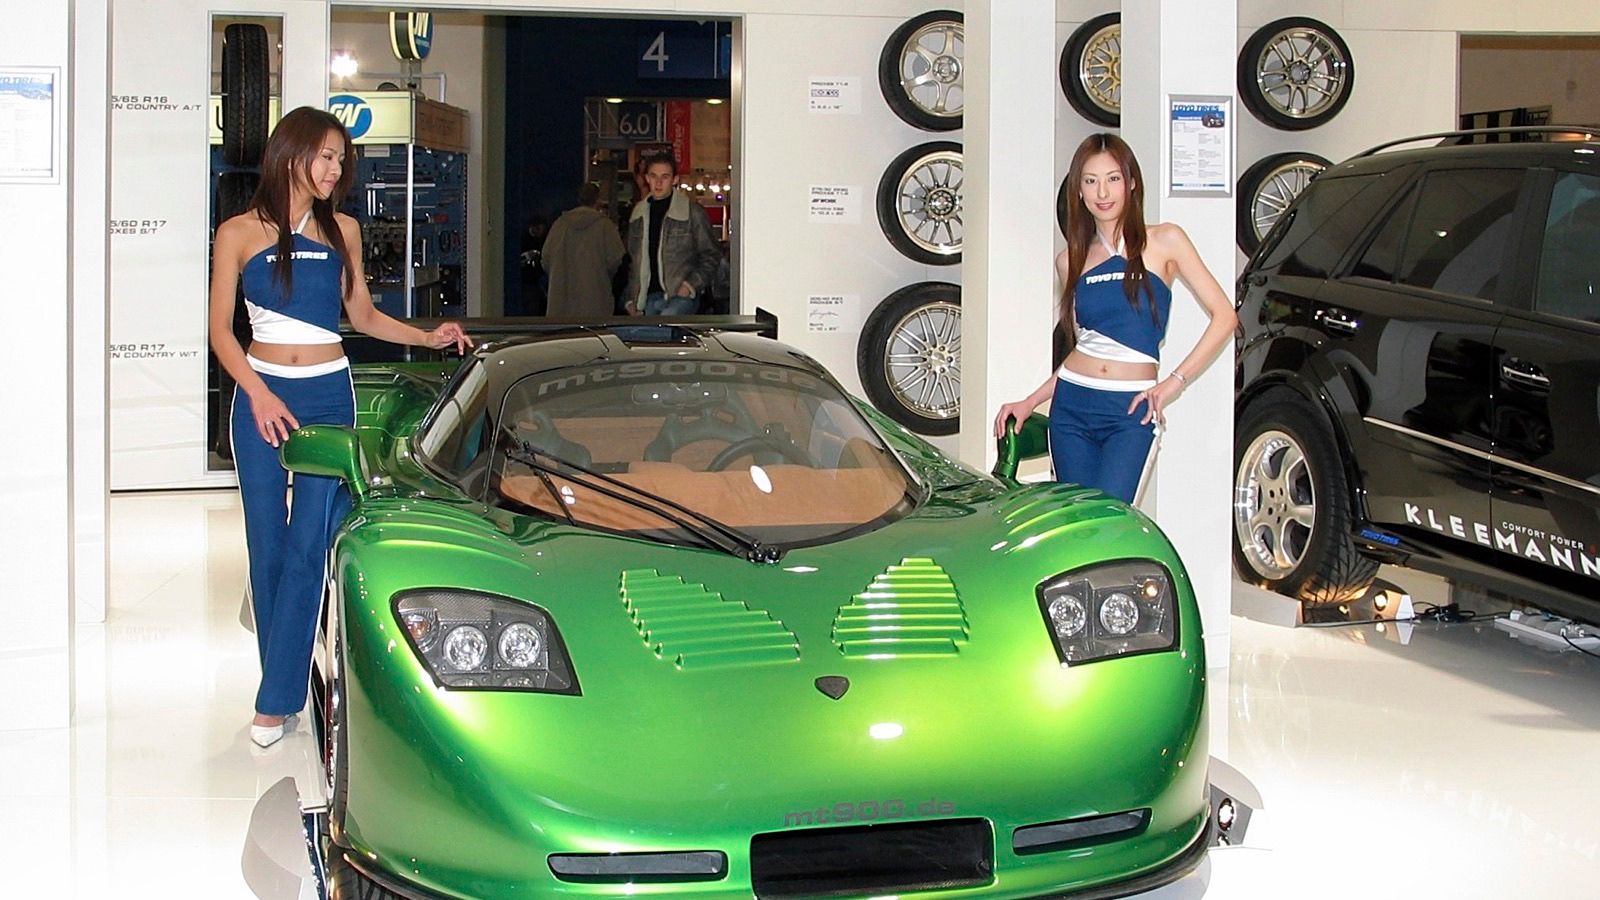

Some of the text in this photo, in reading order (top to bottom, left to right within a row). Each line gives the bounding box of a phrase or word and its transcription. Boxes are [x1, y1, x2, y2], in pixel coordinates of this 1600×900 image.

[642, 31, 669, 72] 4
[143, 95, 168, 103] R16
[126, 103, 178, 111] COUNTRY
[619, 113, 650, 134] 6.0
[141, 219, 167, 228] R17
[1085, 273, 1112, 284] TOYO
[140, 343, 166, 352] R17
[179, 351, 199, 359] W/T
[1404, 502, 1600, 577] KLEEMANN
[1502, 521, 1585, 551] COMFORT POWER
[784, 798, 957, 827] mt900.de
